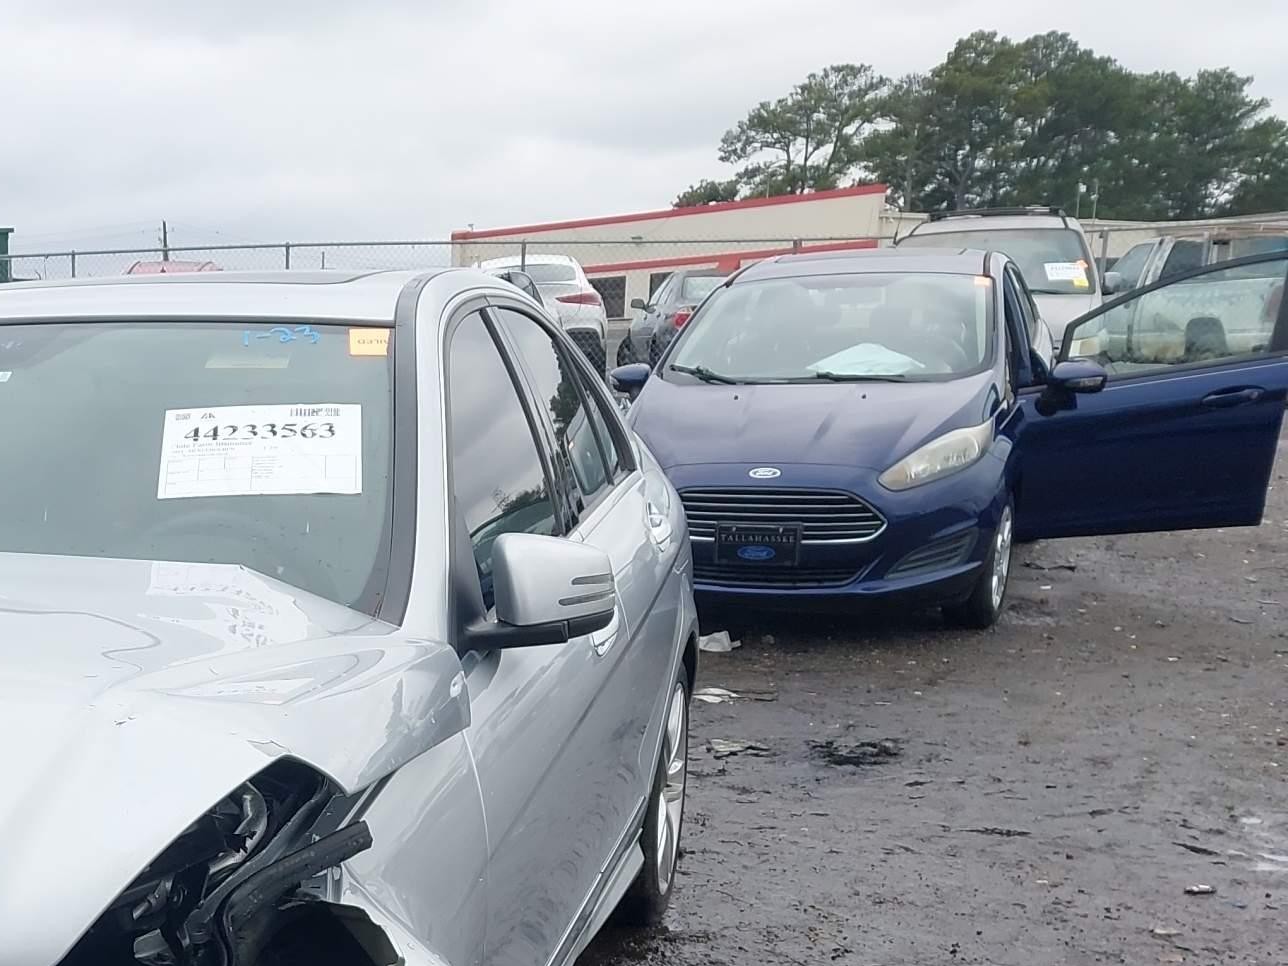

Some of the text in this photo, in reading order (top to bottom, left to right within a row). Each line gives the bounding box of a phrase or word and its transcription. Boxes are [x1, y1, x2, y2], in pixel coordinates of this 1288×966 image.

[243, 325, 321, 347] 1-23
[183, 422, 337, 442] 44233563
[721, 534, 795, 543] TALLAHASSEE
